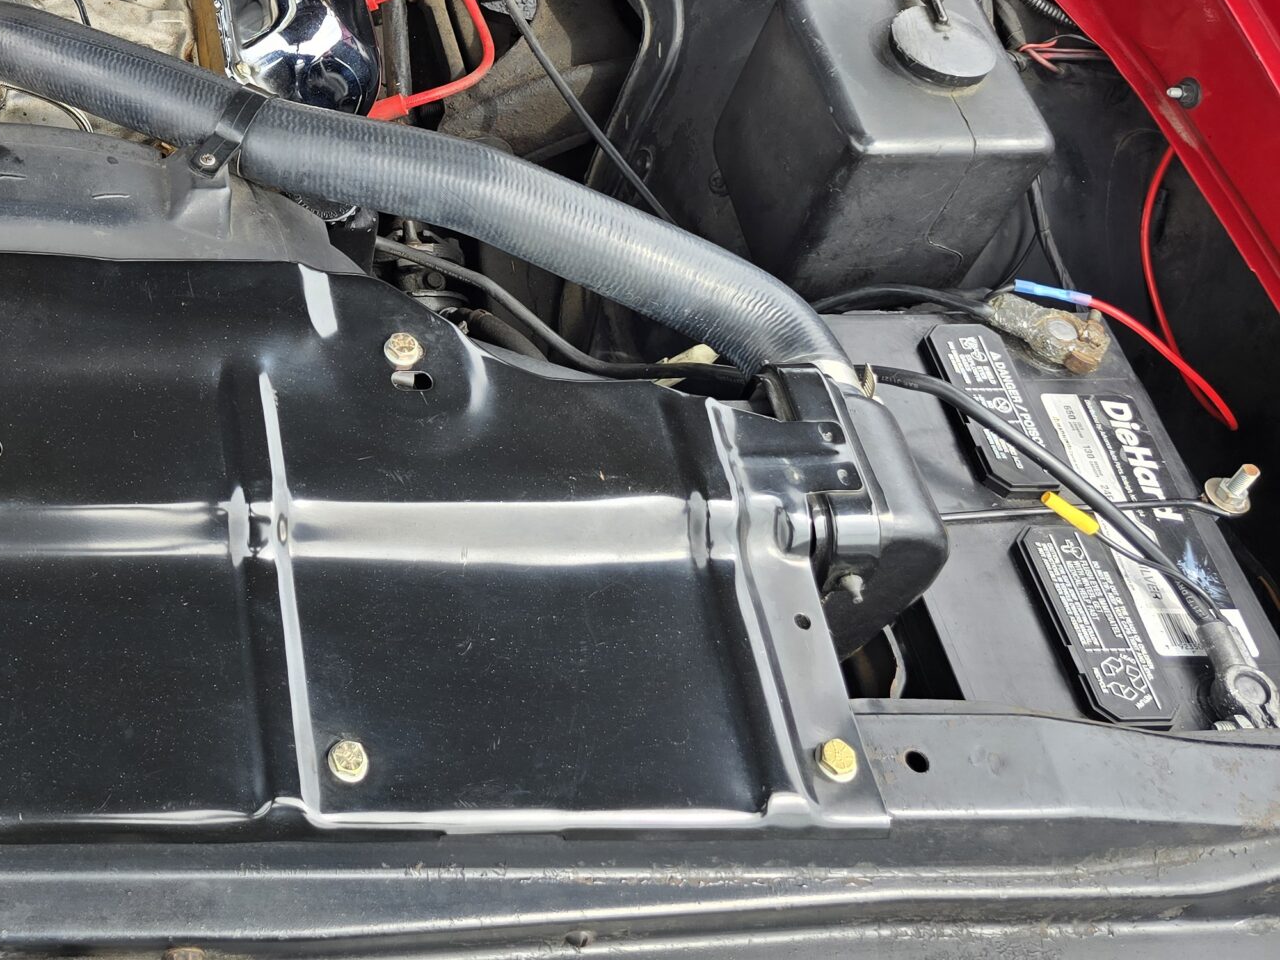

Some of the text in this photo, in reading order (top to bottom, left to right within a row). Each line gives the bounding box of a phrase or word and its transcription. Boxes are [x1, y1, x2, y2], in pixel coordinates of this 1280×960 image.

[995, 362, 1024, 403] DANGER
[1099, 400, 1184, 520] DieHard
[1108, 450, 1118, 461] Auto
[1063, 405, 1076, 419] 650
[1082, 445, 1095, 458] 130
[1137, 565, 1163, 598] ILVER
[1037, 547, 1046, 557] NOT
[1056, 564, 1065, 574] FOR
[1085, 626, 1099, 645] FOLLOW
[1065, 561, 1098, 620] MEDICAL HELP FAST
[1073, 561, 1085, 575] WITH
[1091, 601, 1102, 612] GET
[1080, 560, 1122, 637] FLUSH EYES IMMEDIATELY
[1109, 585, 1118, 596] OUT
[1115, 596, 1123, 604] OF
[1119, 606, 1128, 615] THE
[1125, 616, 1137, 633] REACH
[1133, 634, 1141, 642] OF
[1174, 581, 1188, 594] DRY
[1096, 570, 1105, 579] NOT
[1121, 620, 1131, 634] CAPS
[1136, 652, 1145, 663] AND
[1092, 667, 1108, 693] RECYCLE
